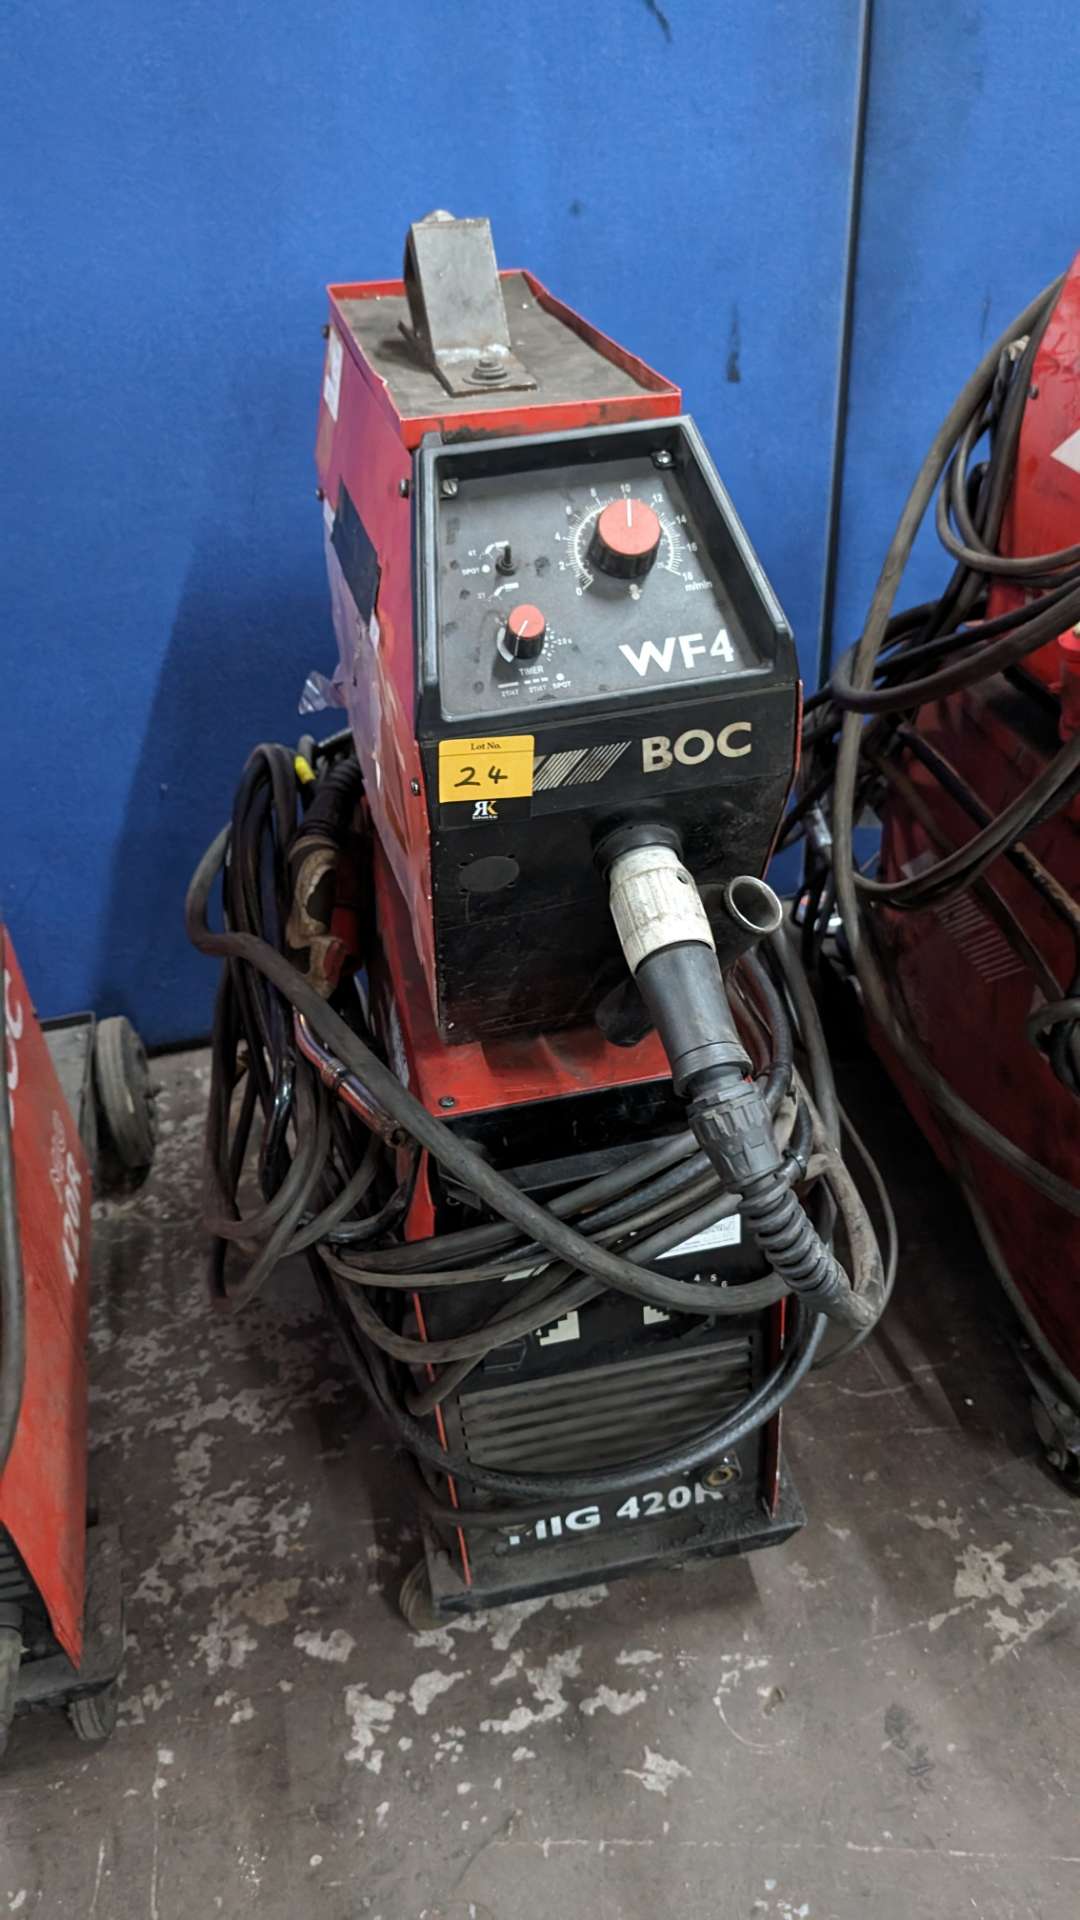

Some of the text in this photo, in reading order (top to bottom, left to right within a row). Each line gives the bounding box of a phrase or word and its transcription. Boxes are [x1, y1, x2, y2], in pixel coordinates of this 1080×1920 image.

[620, 483, 631, 493] 10
[652, 494, 664, 503] 12
[676, 516, 687, 524] 14
[554, 532, 561, 541] 4
[686, 544, 698, 552] 16
[558, 562, 566, 571] 2
[461, 567, 480, 576] SPOT
[576, 587, 583, 596] 0
[618, 629, 736, 677] WF4
[518, 665, 544, 675] TIMER
[552, 681, 571, 690] SPOT
[470, 741, 502, 751] Lot No.
[642, 721, 752, 773] BOC
[453, 765, 508, 788] 24
[694, 1273, 701, 1282] 4
[710, 1273, 717, 1282] 5
